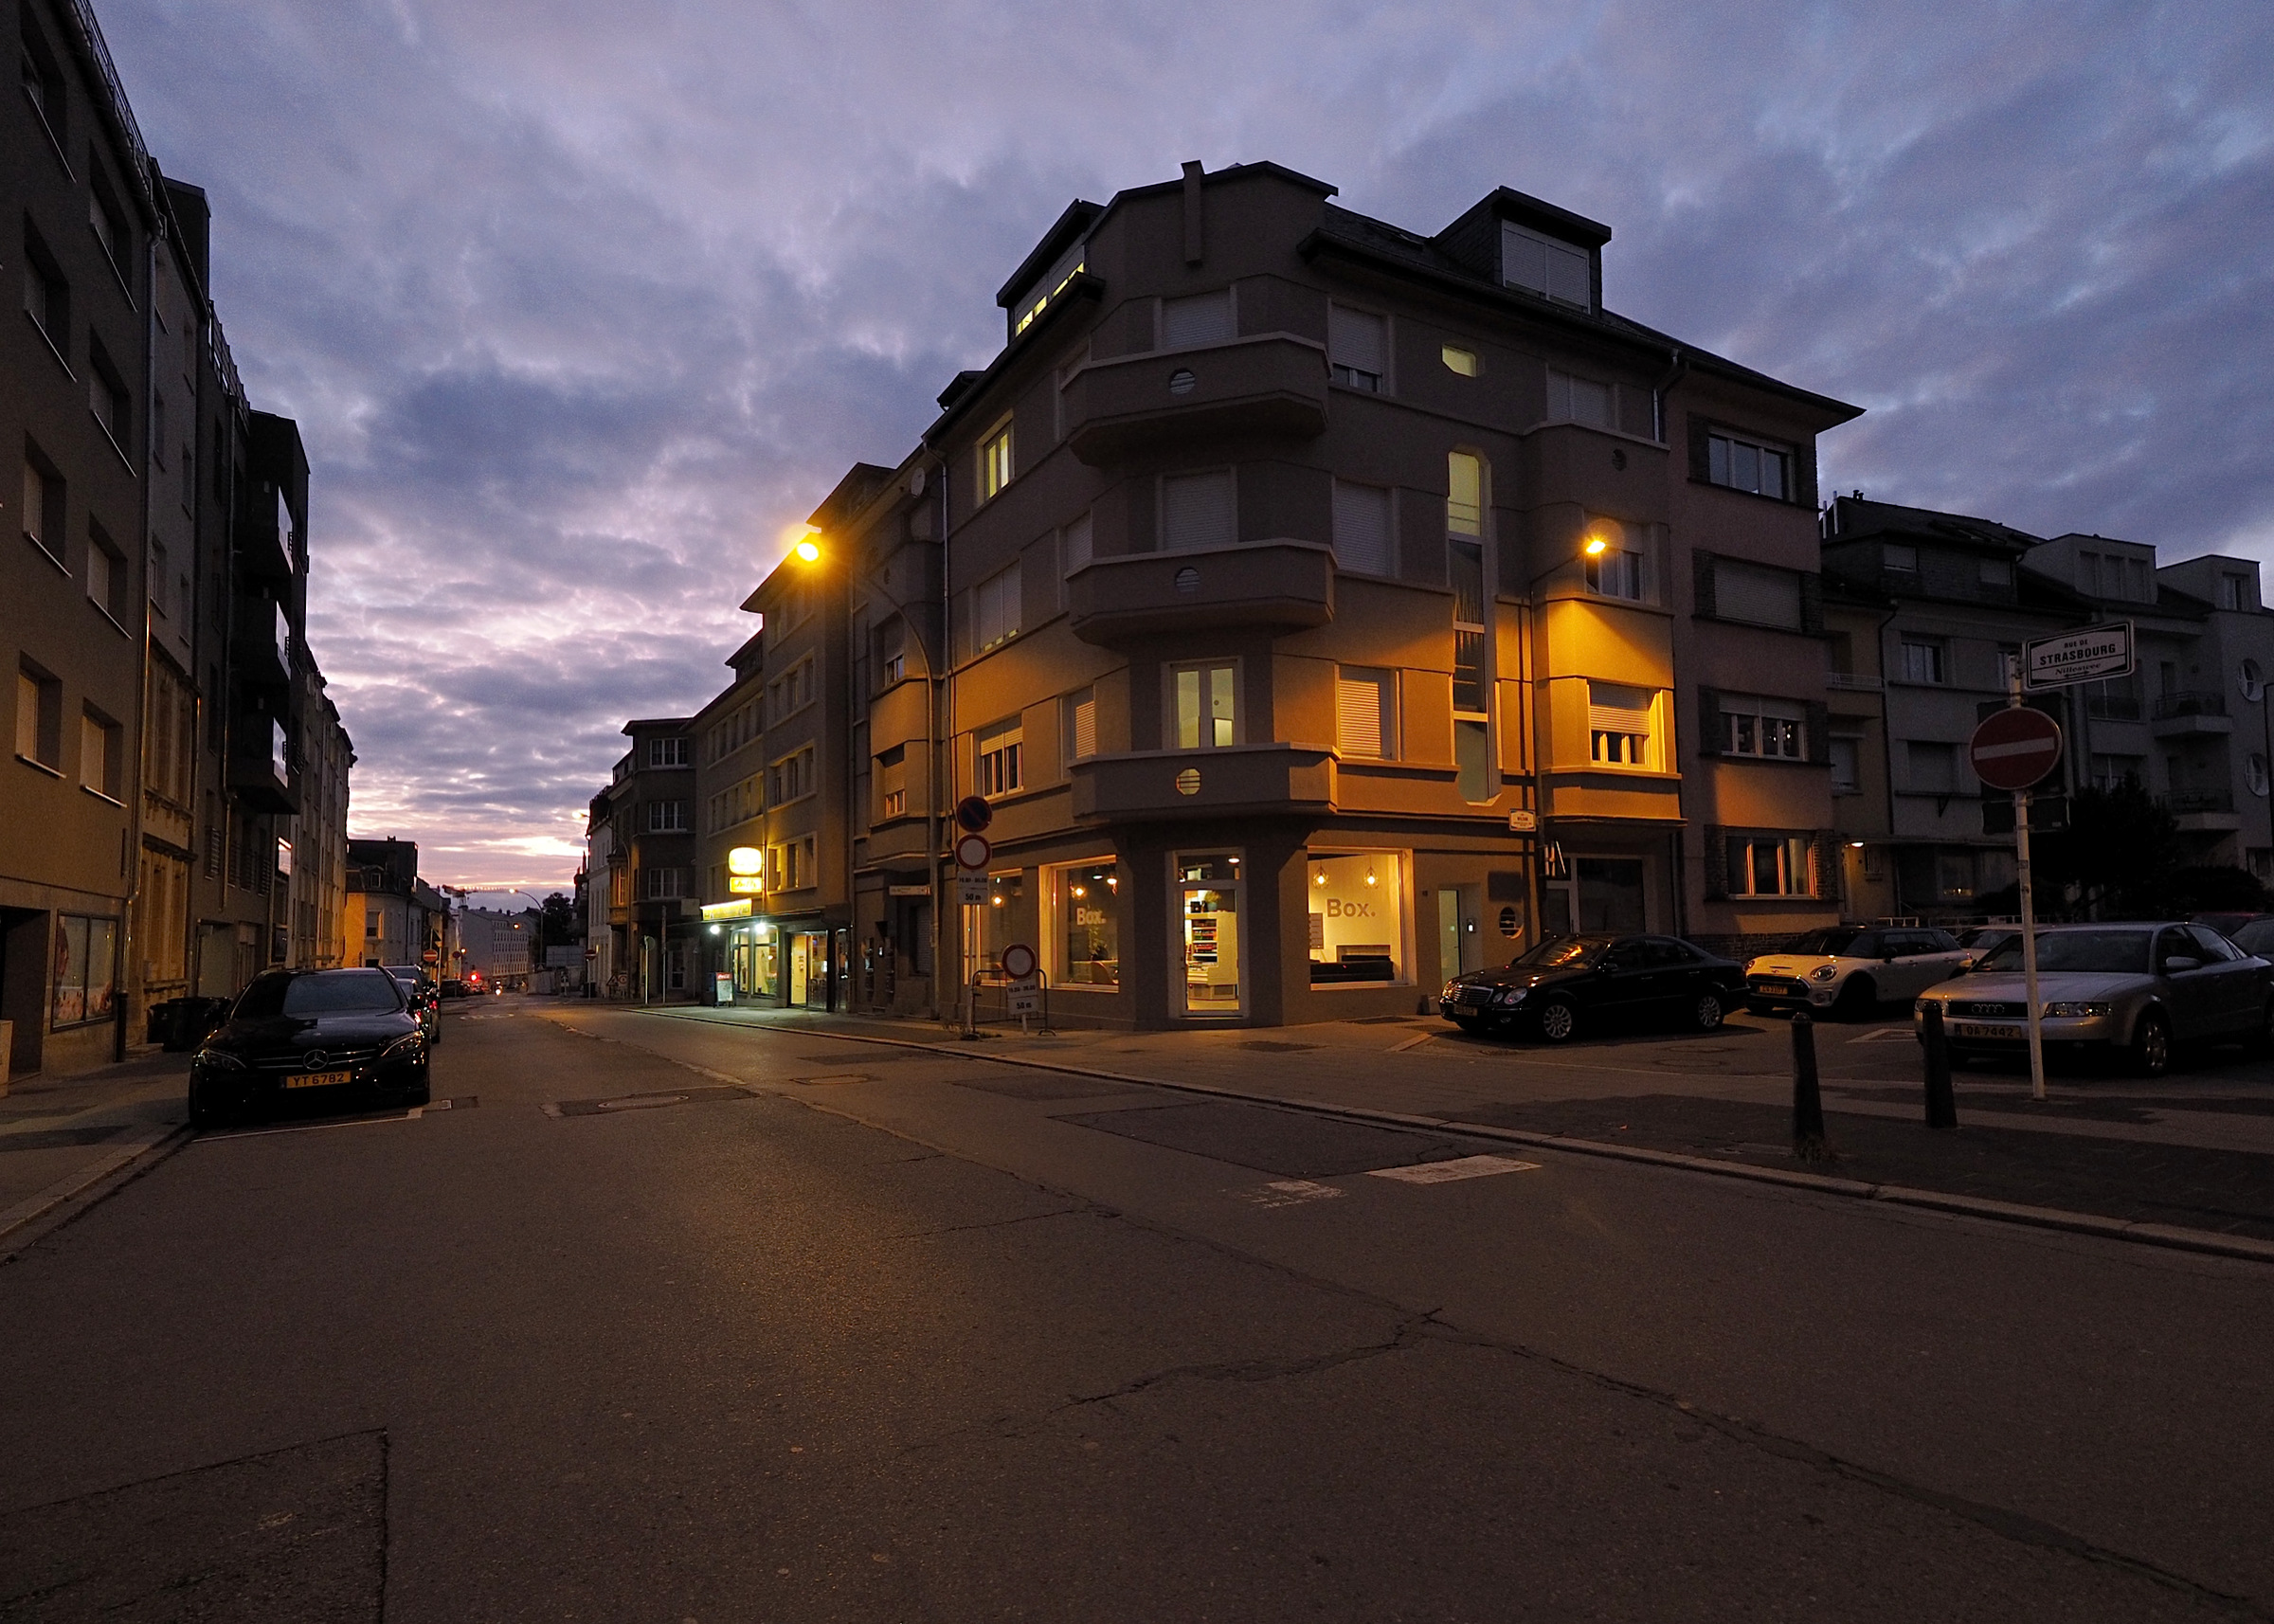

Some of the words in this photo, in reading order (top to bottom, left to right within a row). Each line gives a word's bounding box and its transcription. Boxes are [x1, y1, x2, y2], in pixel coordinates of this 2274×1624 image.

[2064, 640, 2077, 649] RUE
[2039, 643, 2117, 666] STRASBOURG
[1326, 898, 1376, 918] Box.
[1075, 907, 1107, 926] Box.
[1982, 1026, 2014, 1038] 7442
[293, 1075, 309, 1087] YT
[312, 1073, 345, 1085] 6782
